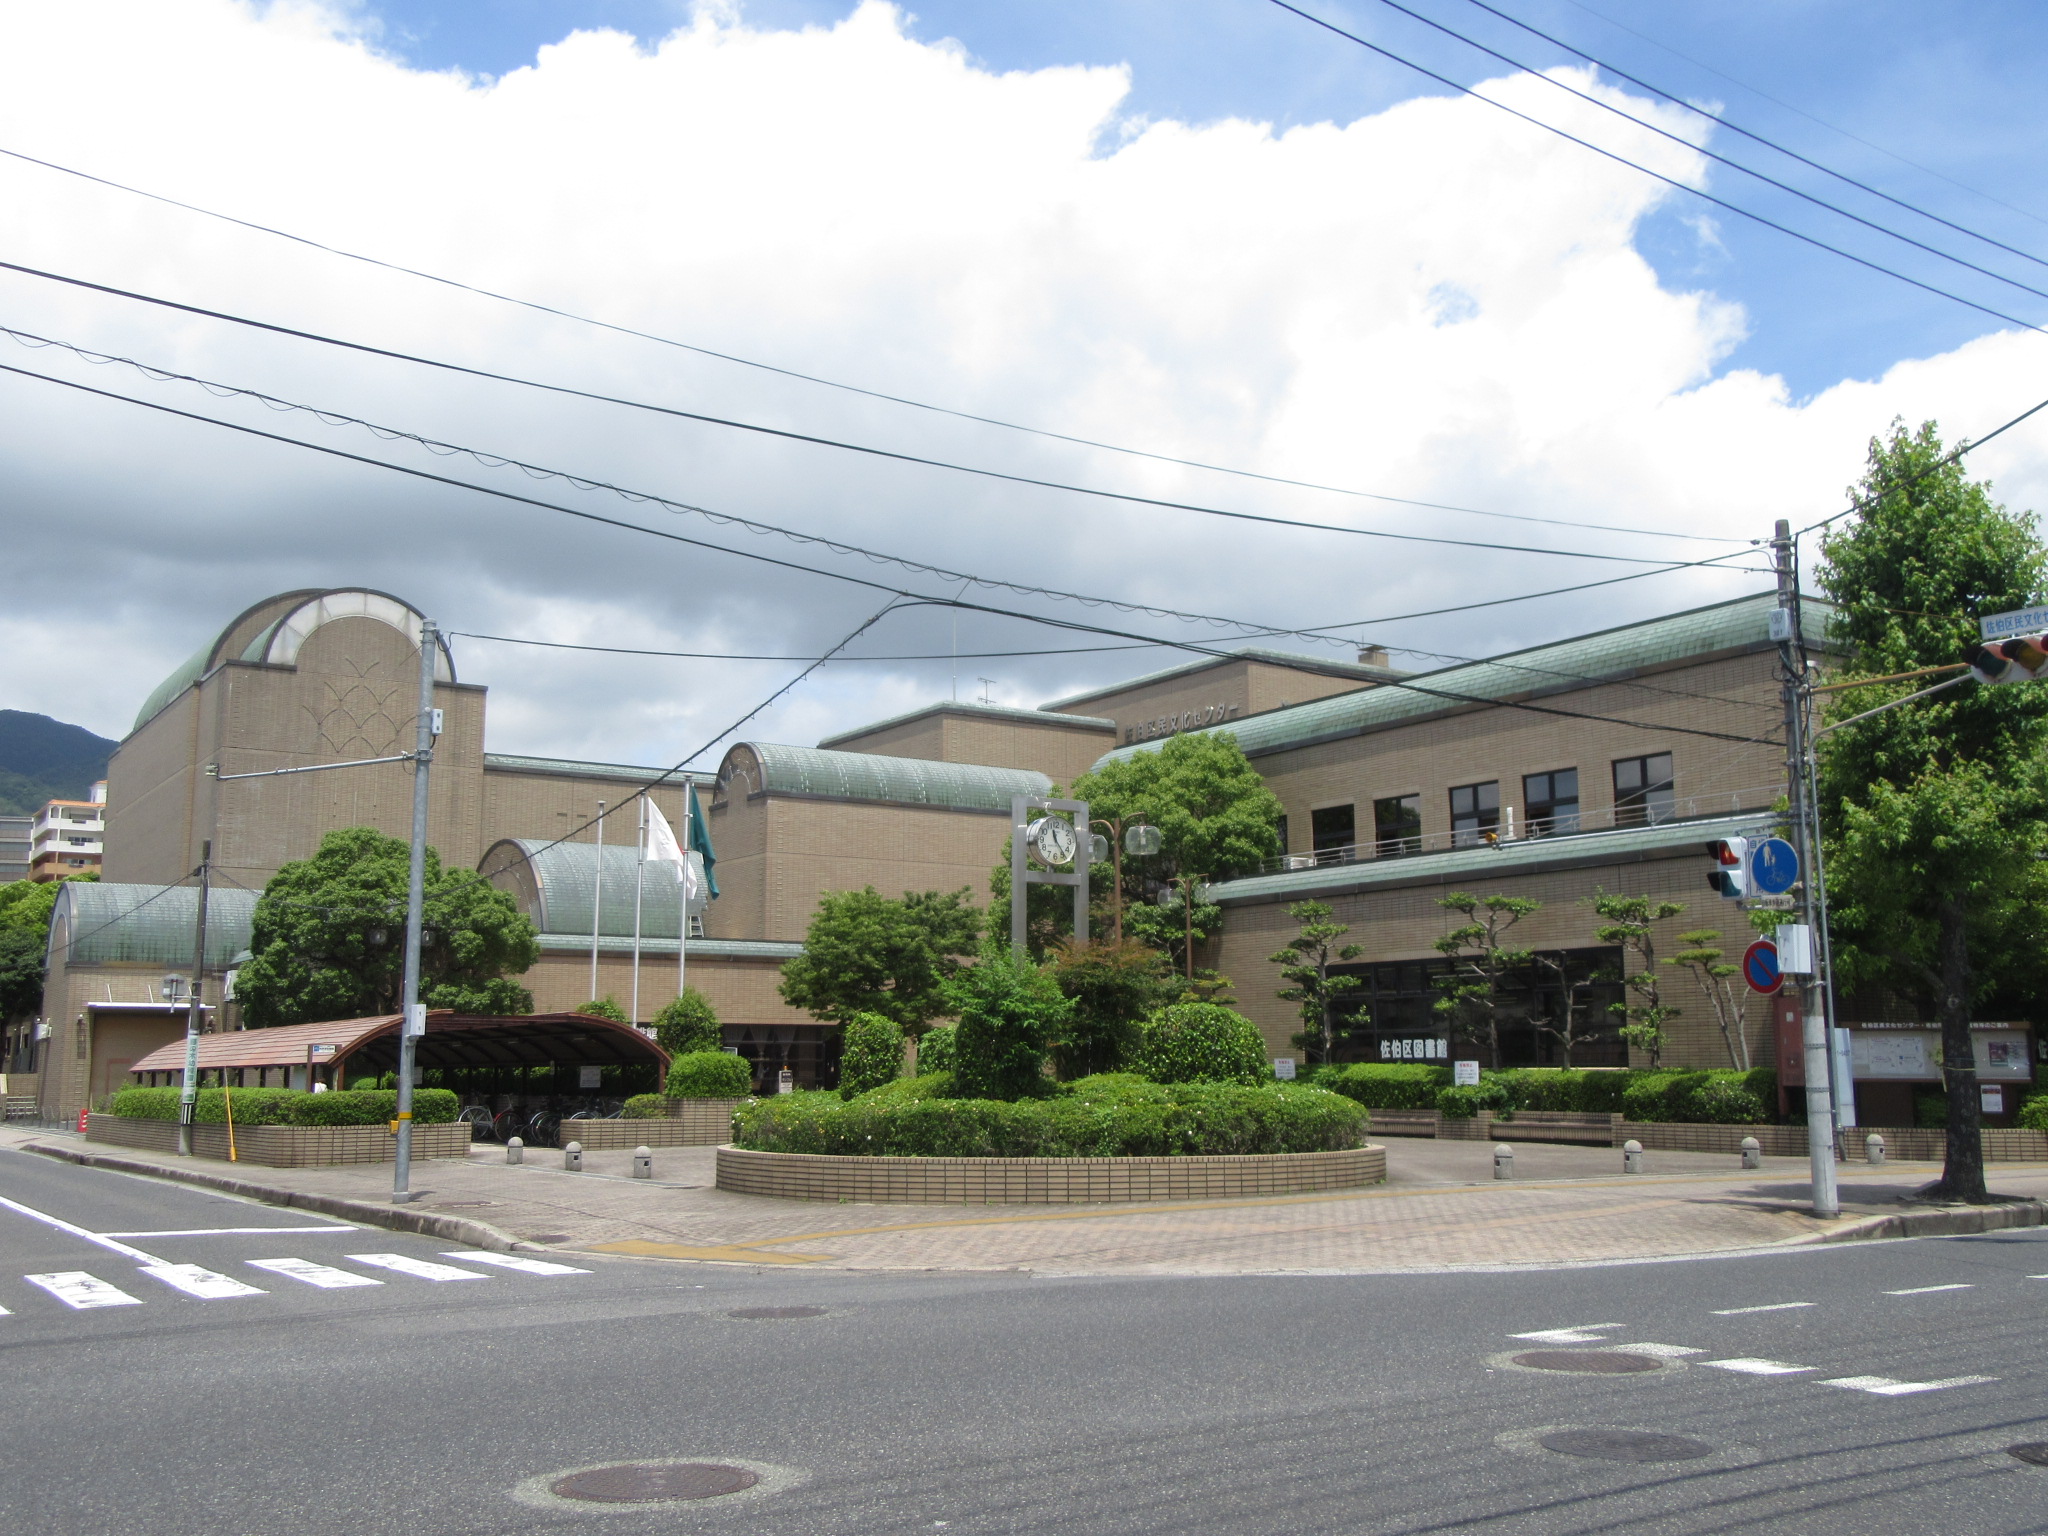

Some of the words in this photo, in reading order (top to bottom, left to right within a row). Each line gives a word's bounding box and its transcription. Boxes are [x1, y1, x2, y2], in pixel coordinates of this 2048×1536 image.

[1126, 703, 1238, 741] 佐伯区民文化センター
[1380, 1038, 1448, 1059] 佐伯区図書館
